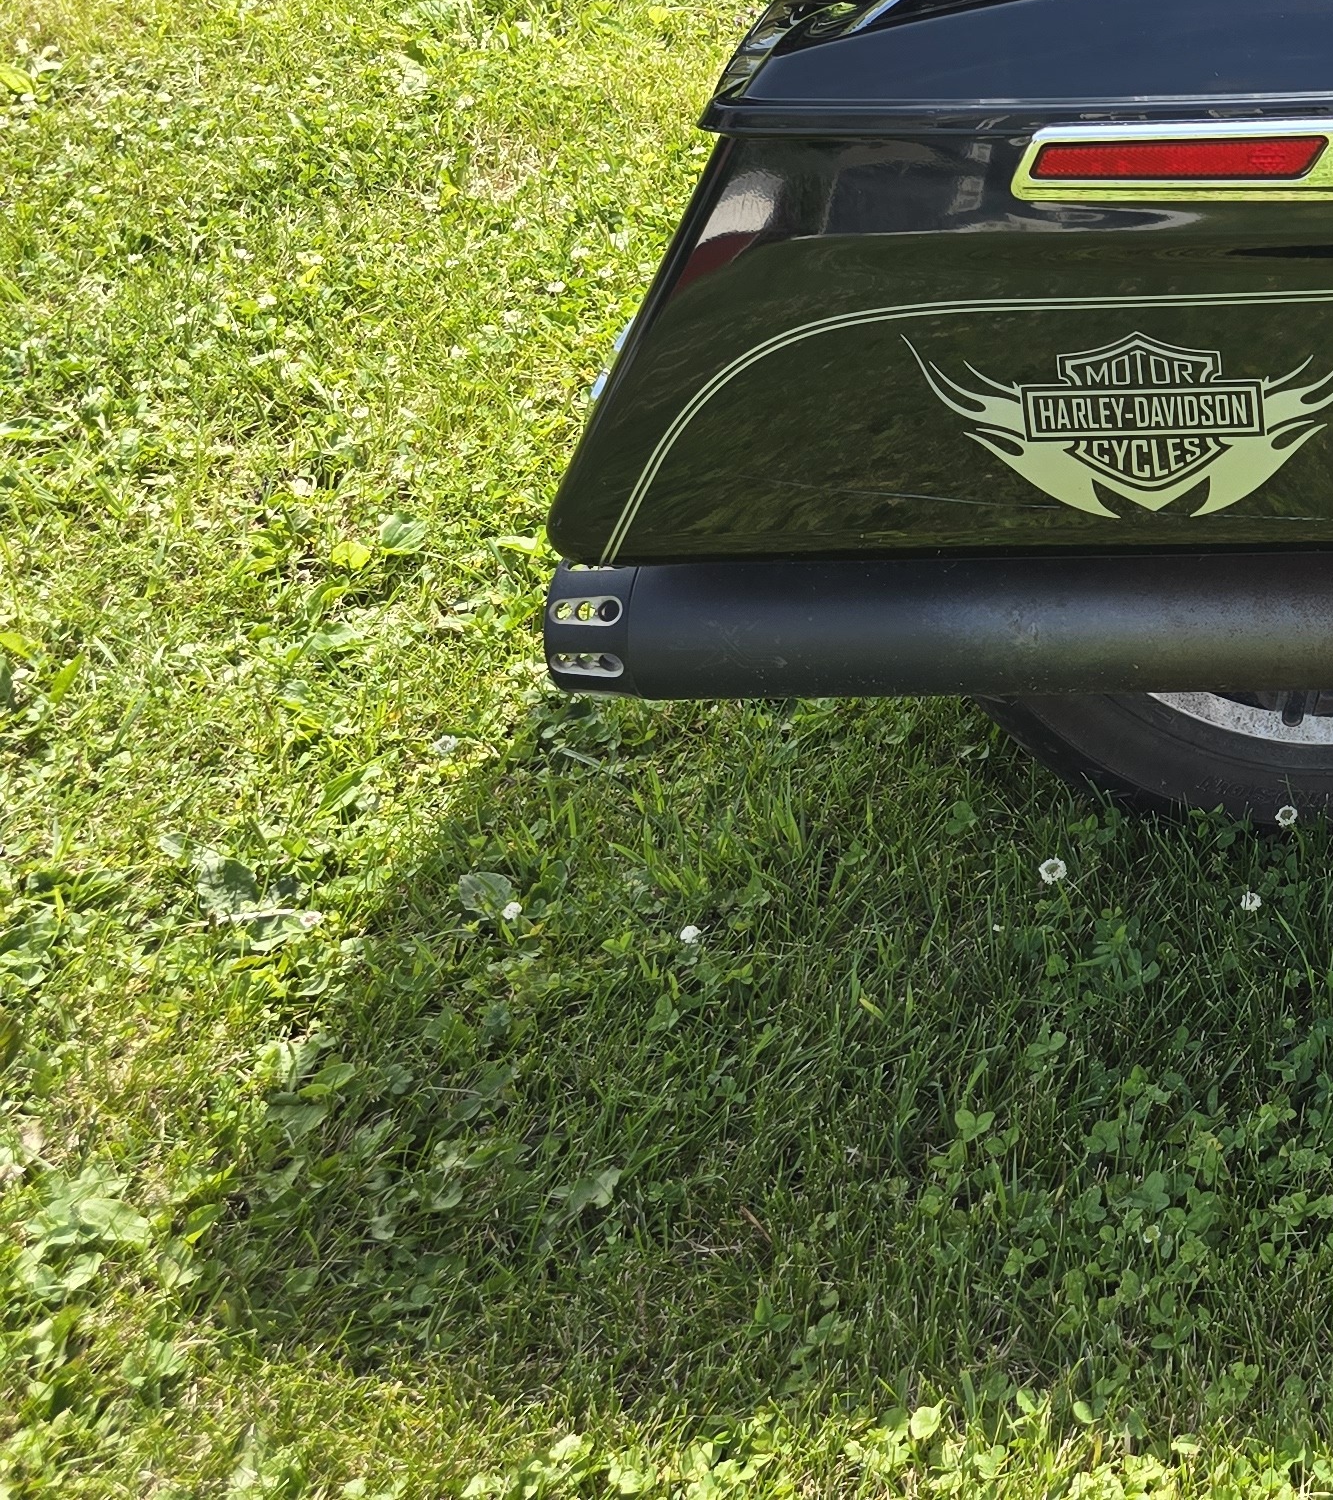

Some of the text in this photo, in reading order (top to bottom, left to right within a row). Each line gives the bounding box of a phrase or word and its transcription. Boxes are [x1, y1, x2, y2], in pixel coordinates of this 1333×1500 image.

[1085, 349, 1194, 386] MOTOR
[1038, 394, 1249, 431] HARLEY-DAVIDSON
[1093, 437, 1202, 477] CYCLES
